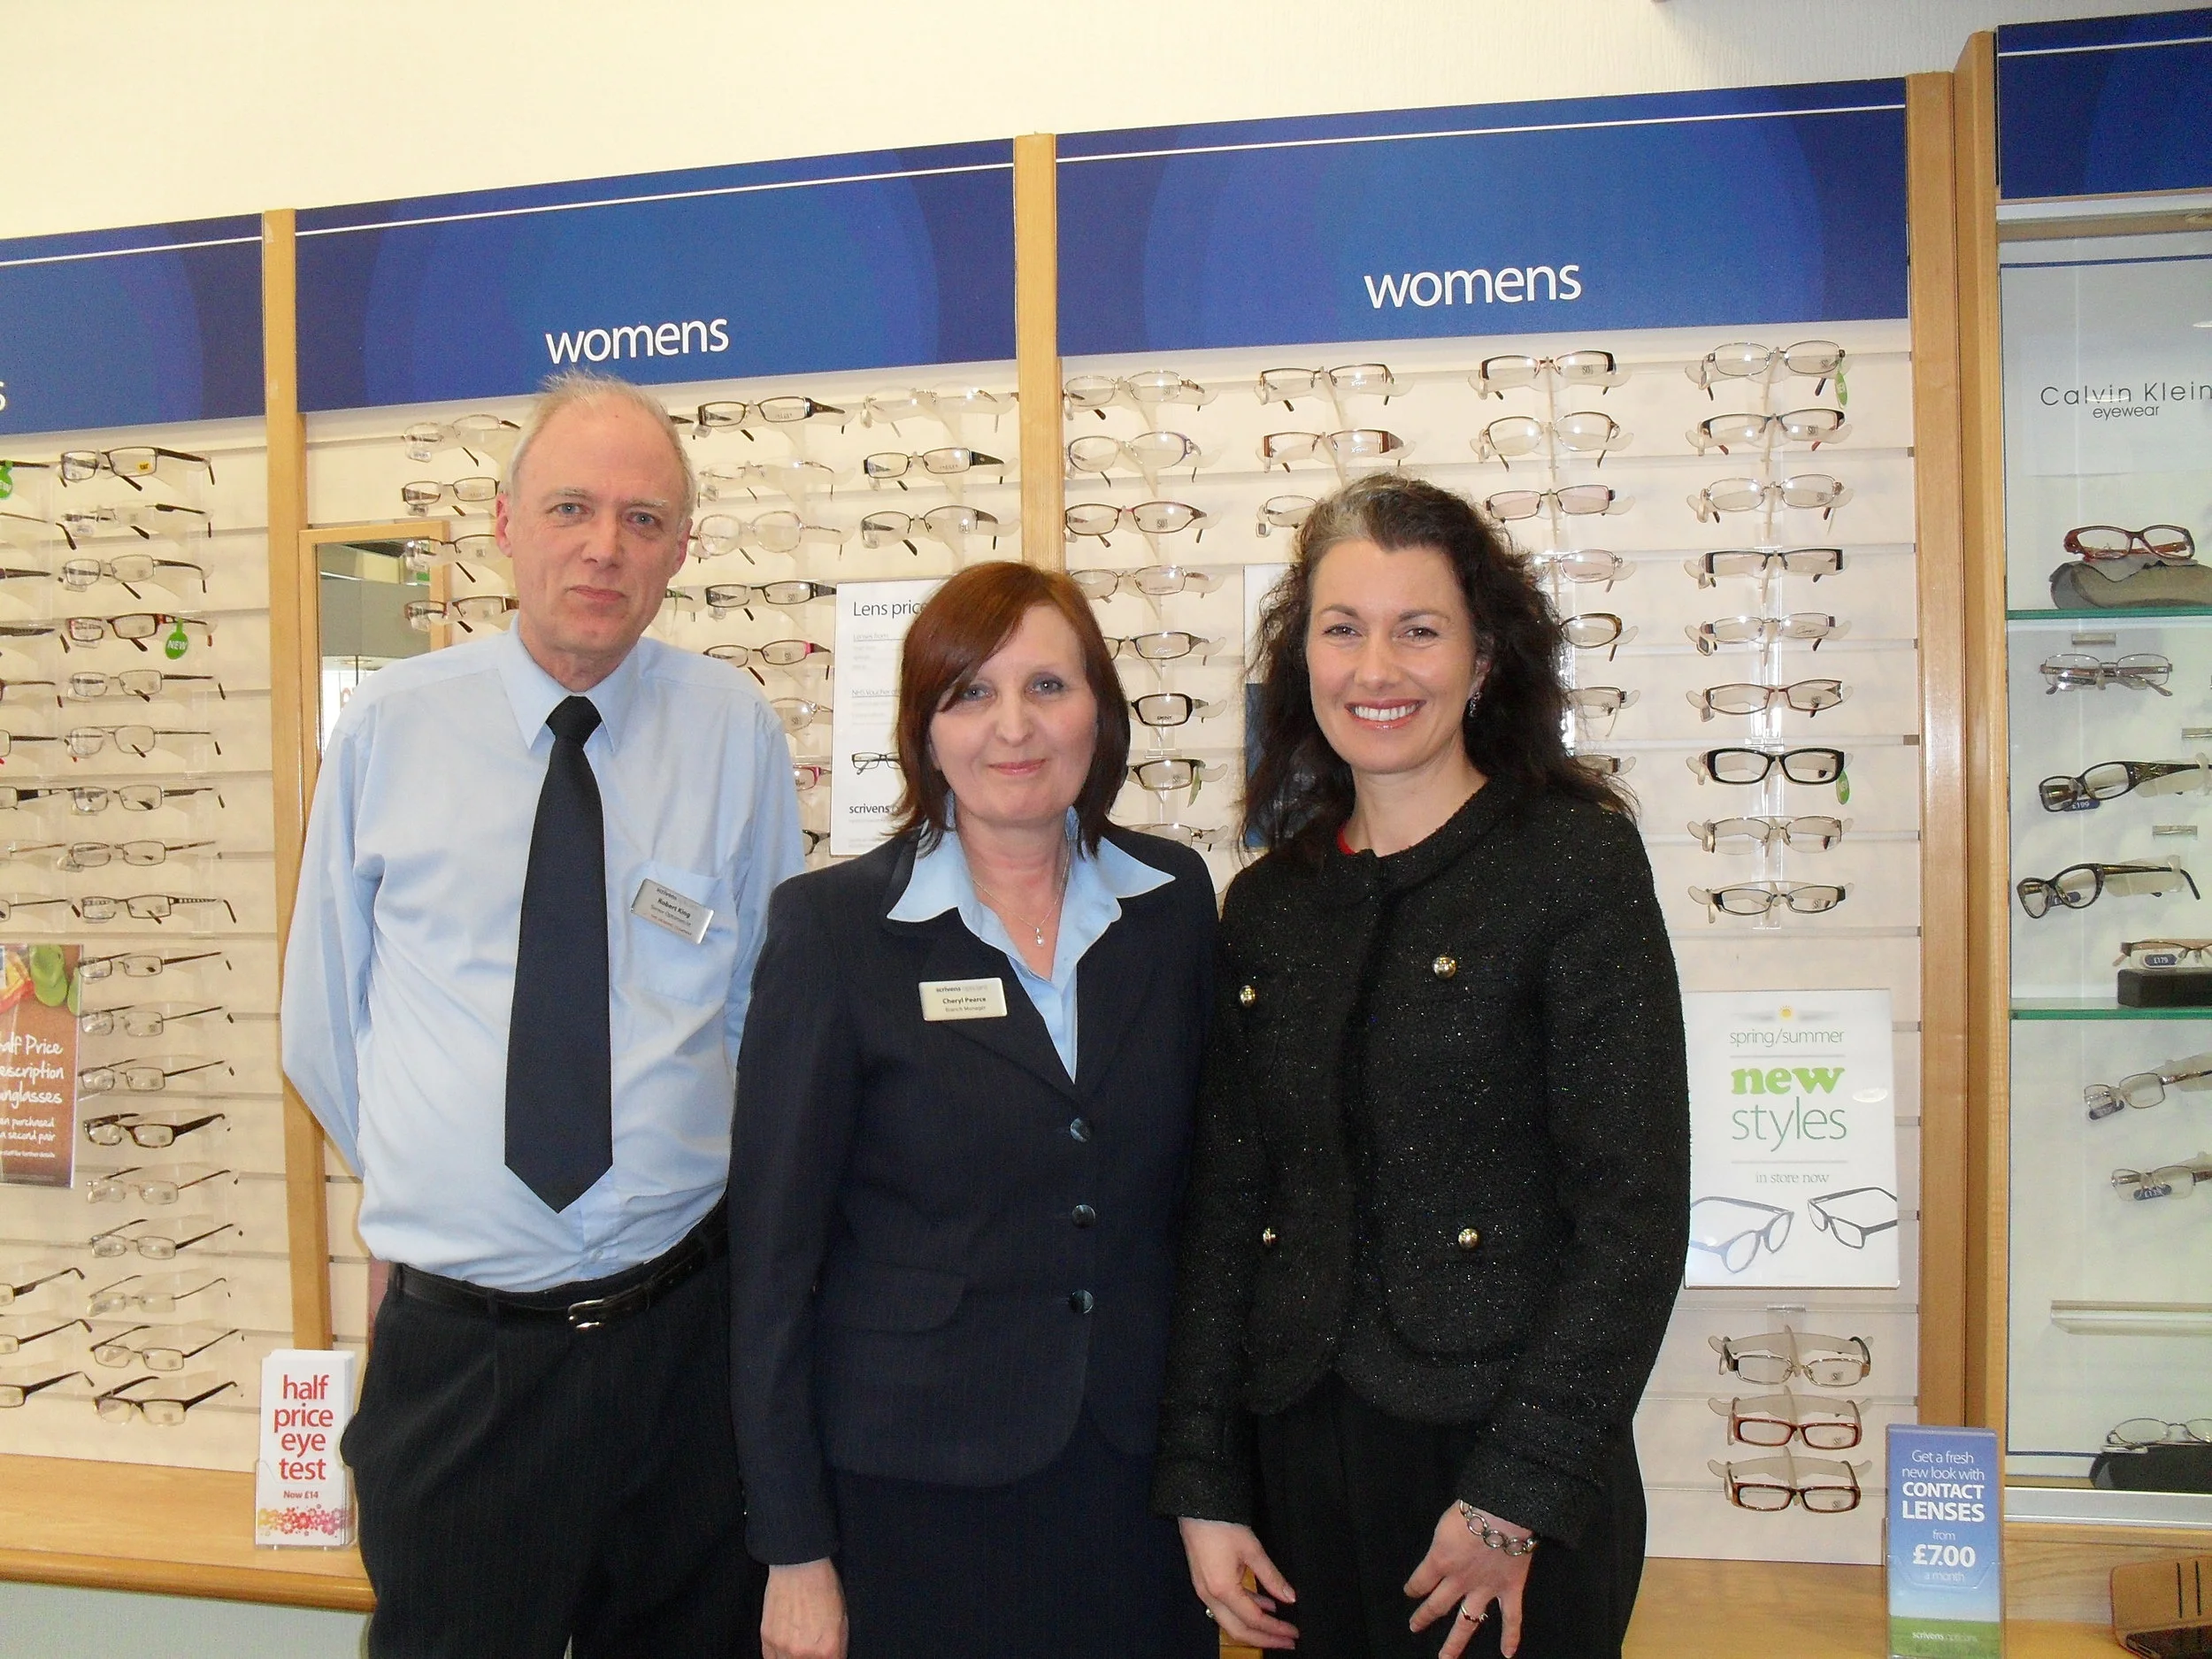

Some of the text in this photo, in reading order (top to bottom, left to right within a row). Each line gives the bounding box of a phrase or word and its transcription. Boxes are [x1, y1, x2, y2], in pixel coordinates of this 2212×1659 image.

[1363, 265, 1582, 309] womens
[545, 319, 729, 365] womens
[2040, 381, 2212, 405] Calvin Klein
[2093, 405, 2160, 420] eyewear
[853, 602, 887, 617] Lens
[166, 640, 188, 650] NEW
[849, 803, 890, 814] scrivens
[657, 897, 678, 912] Robert
[677, 907, 691, 918] King
[26, 1033, 64, 1056] Price
[1730, 1027, 1845, 1048] spring/summer
[1731, 1067, 1846, 1095] new
[12, 1116, 55, 1130] purchased
[1732, 1096, 1847, 1152] styles
[8, 1129, 36, 1141] second
[38, 1131, 56, 1144] pair
[1755, 1171, 1830, 1184] in store now
[282, 1374, 329, 1400] half
[273, 1402, 334, 1432] price
[280, 1432, 326, 1458] eye
[1911, 1449, 1974, 1464] Get a fresh
[279, 1458, 326, 1480] test
[1901, 1466, 1985, 1481] new look with
[283, 1490, 319, 1499] Now £14
[1902, 1481, 1985, 1500] CONTACT
[1901, 1500, 1985, 1522] LENSES
[1932, 1529, 1956, 1540] from
[1912, 1544, 1976, 1568] £7.00
[1932, 1571, 1965, 1582] month
